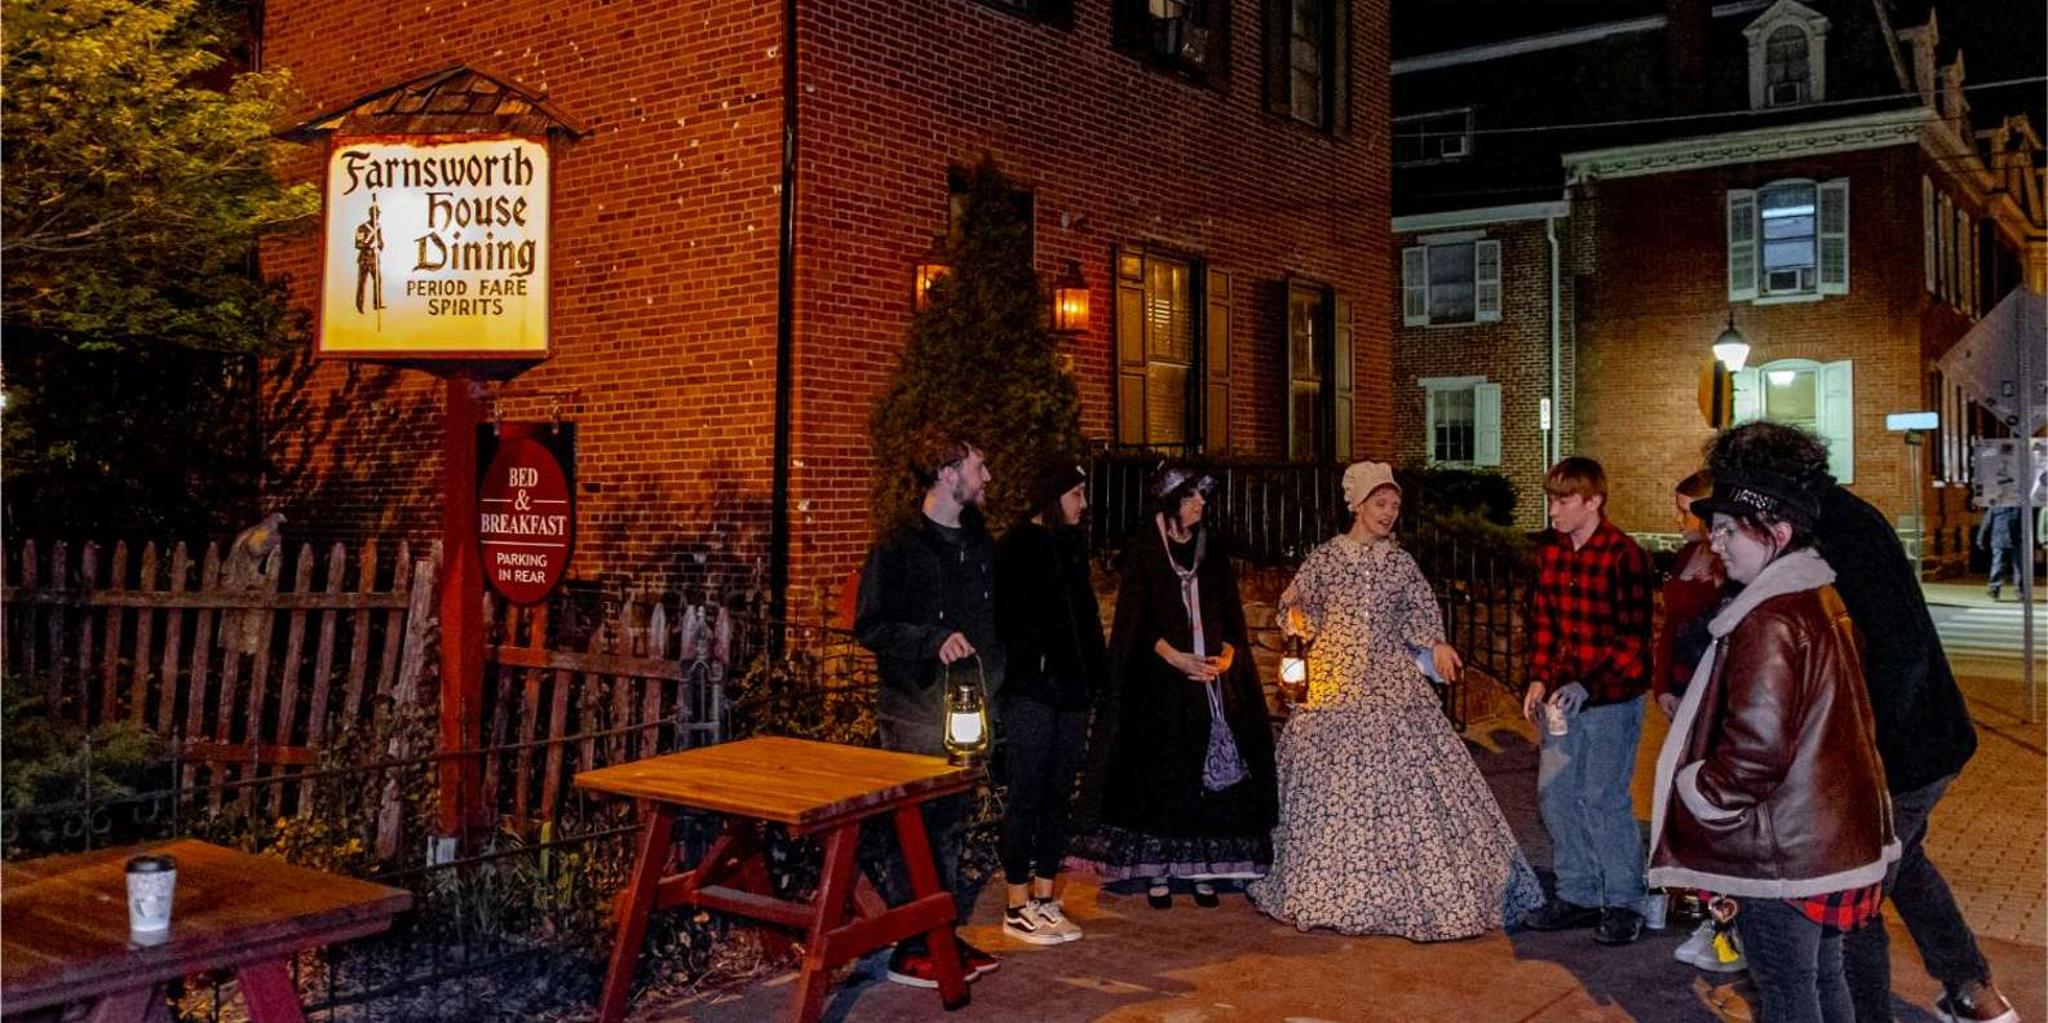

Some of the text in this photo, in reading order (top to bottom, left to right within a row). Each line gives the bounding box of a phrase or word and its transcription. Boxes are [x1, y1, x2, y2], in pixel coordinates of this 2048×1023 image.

[341, 146, 533, 195] Farnsworth
[425, 192, 527, 230] House
[412, 231, 536, 277] Dining
[407, 279, 528, 296] PERIOD FARE
[428, 299, 503, 316] SPIRITS
[508, 467, 538, 487] BED
[514, 488, 531, 511] &
[480, 513, 566, 536] BREAKFAST
[497, 552, 548, 567] PARKING
[499, 569, 546, 584] IN REAR
